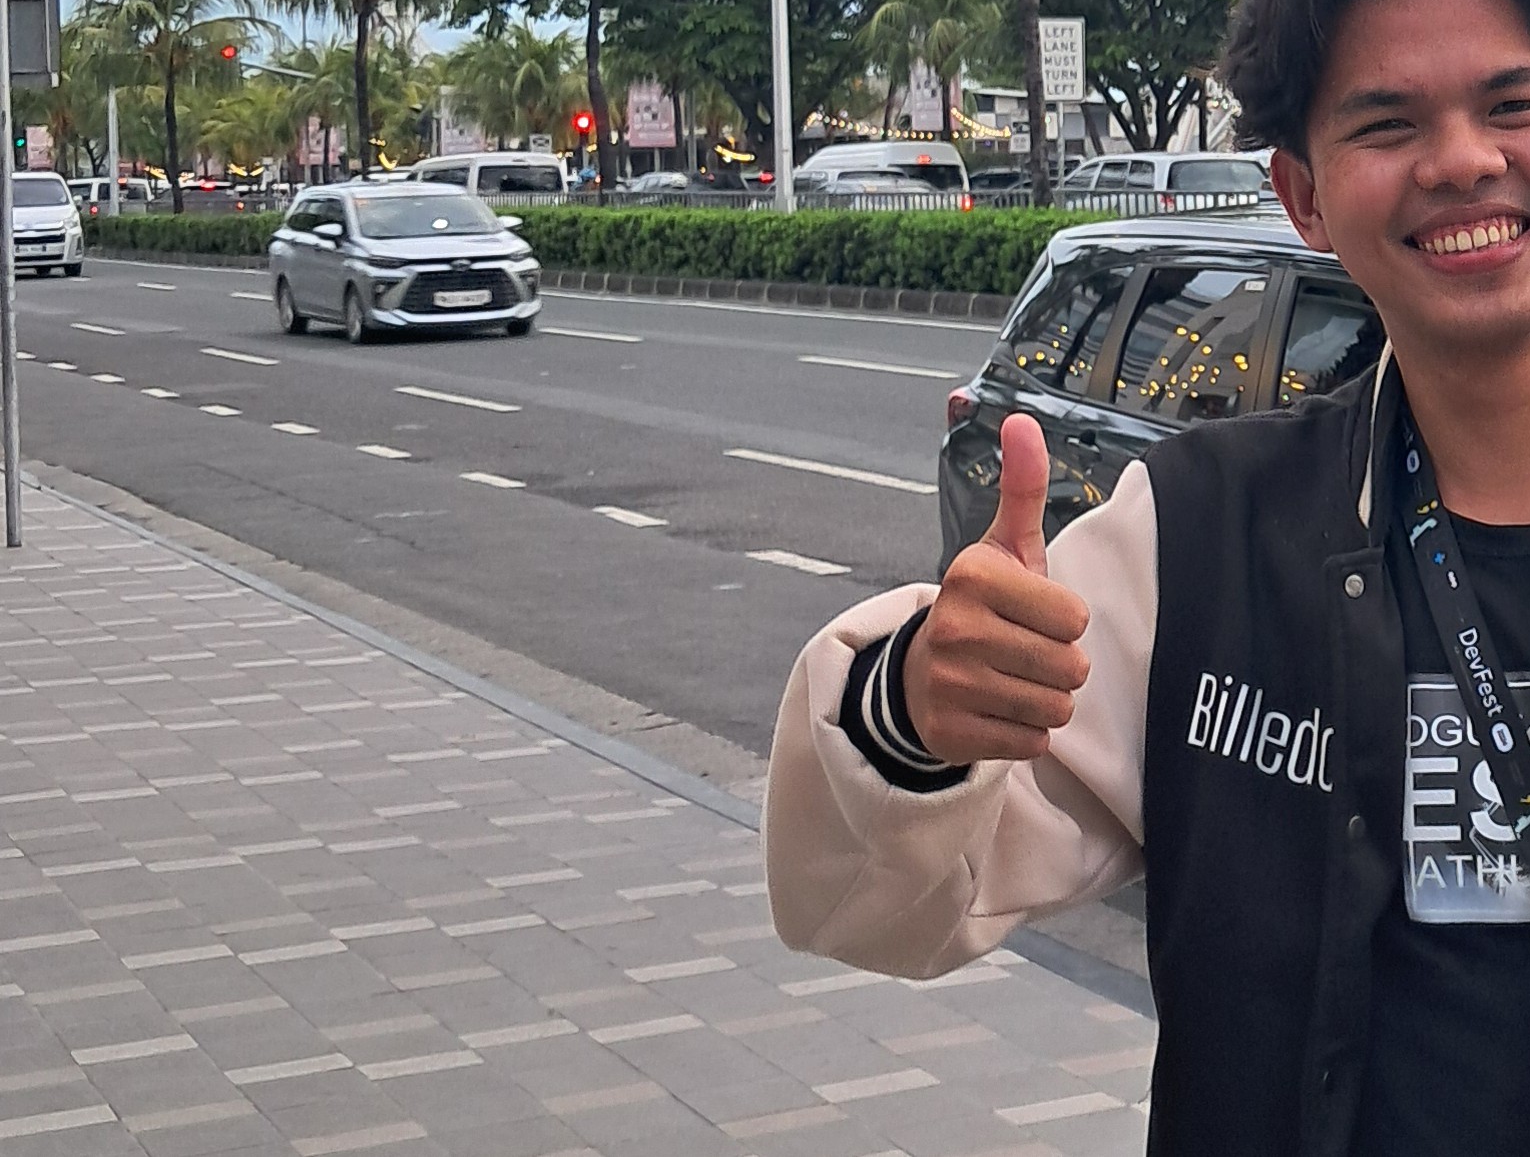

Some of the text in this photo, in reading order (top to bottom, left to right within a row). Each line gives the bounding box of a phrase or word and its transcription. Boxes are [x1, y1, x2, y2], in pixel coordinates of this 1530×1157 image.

[1045, 27, 1074, 38] LEFT
[1045, 42, 1077, 52] LANE
[1045, 56, 1076, 66] MUST
[1045, 71, 1077, 80] TURN
[1047, 85, 1075, 95] LEFT
[1459, 627, 1503, 717] DevFest
